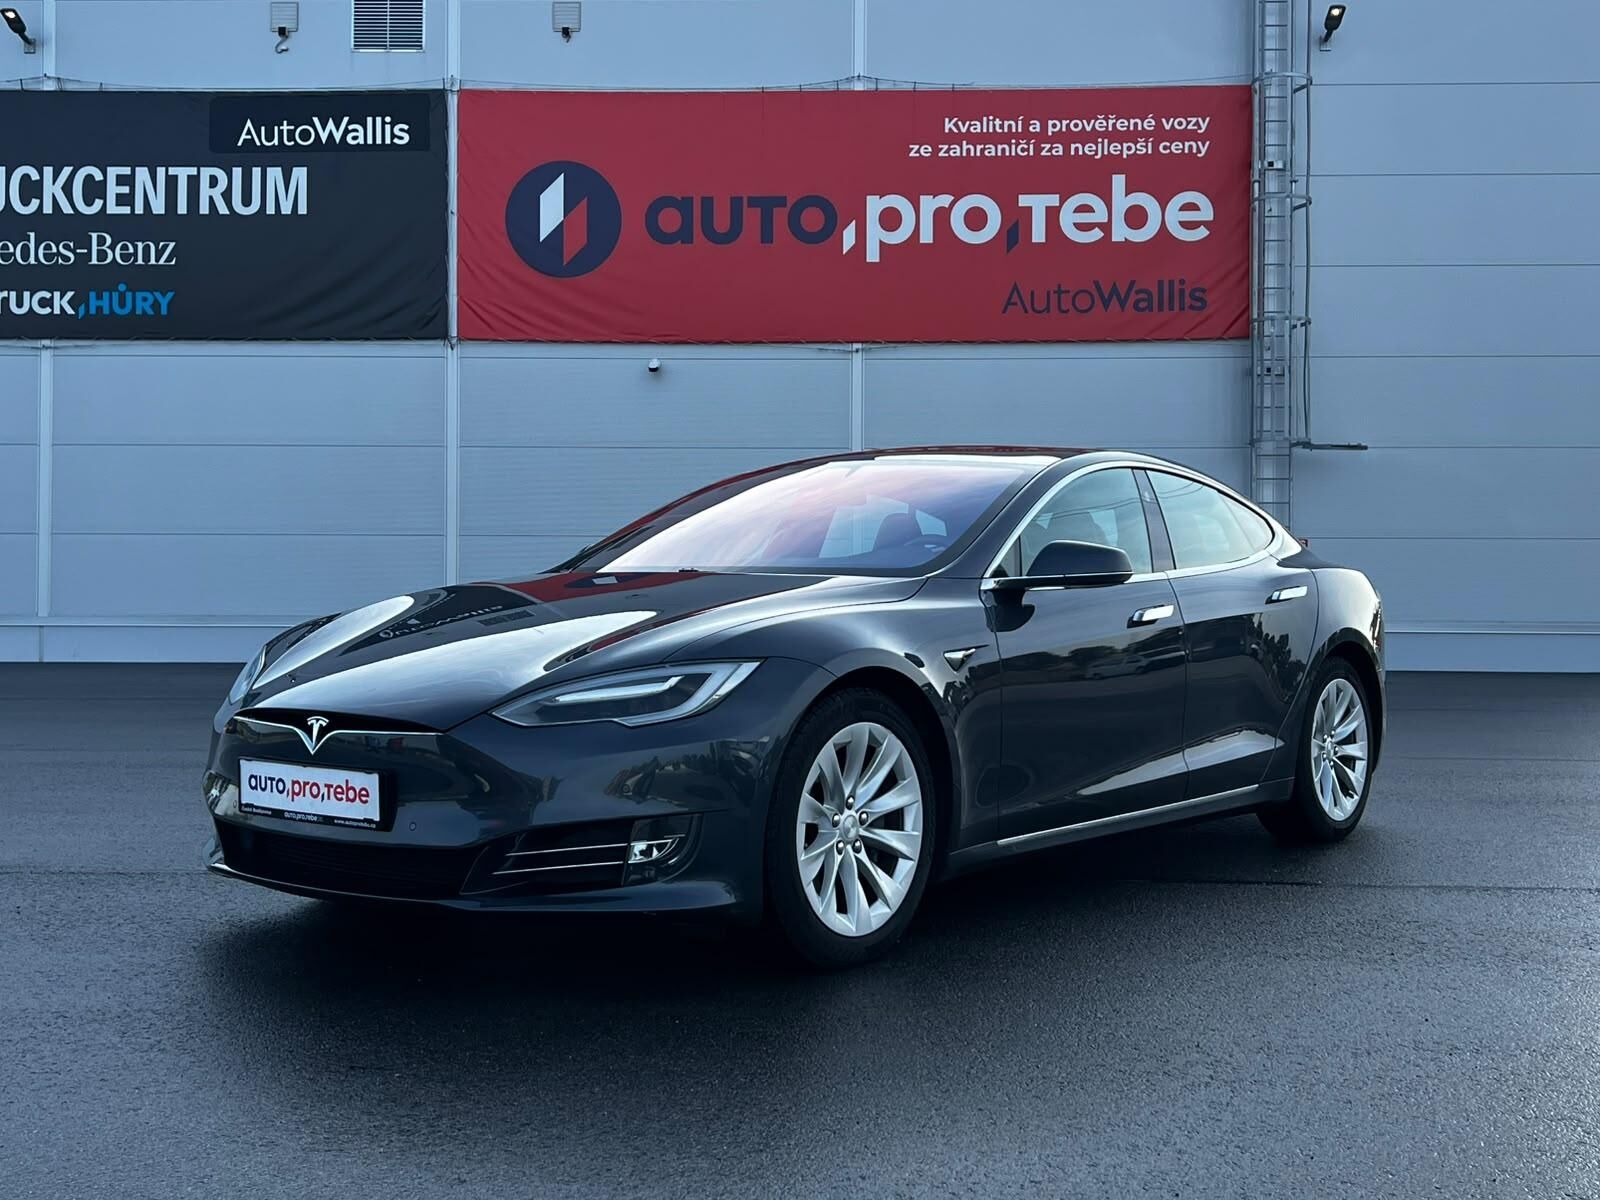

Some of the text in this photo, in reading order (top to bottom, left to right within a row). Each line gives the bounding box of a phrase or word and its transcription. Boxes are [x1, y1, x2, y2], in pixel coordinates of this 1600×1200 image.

[237, 116, 410, 147] AutoWallis
[945, 114, 1210, 136] Kvalitní a prověřené vozy
[909, 138, 1210, 159] ze zahraničí za nejlepší ceny
[0, 166, 307, 215] CKCENTRUM
[1003, 279, 1208, 315] AutoWallis
